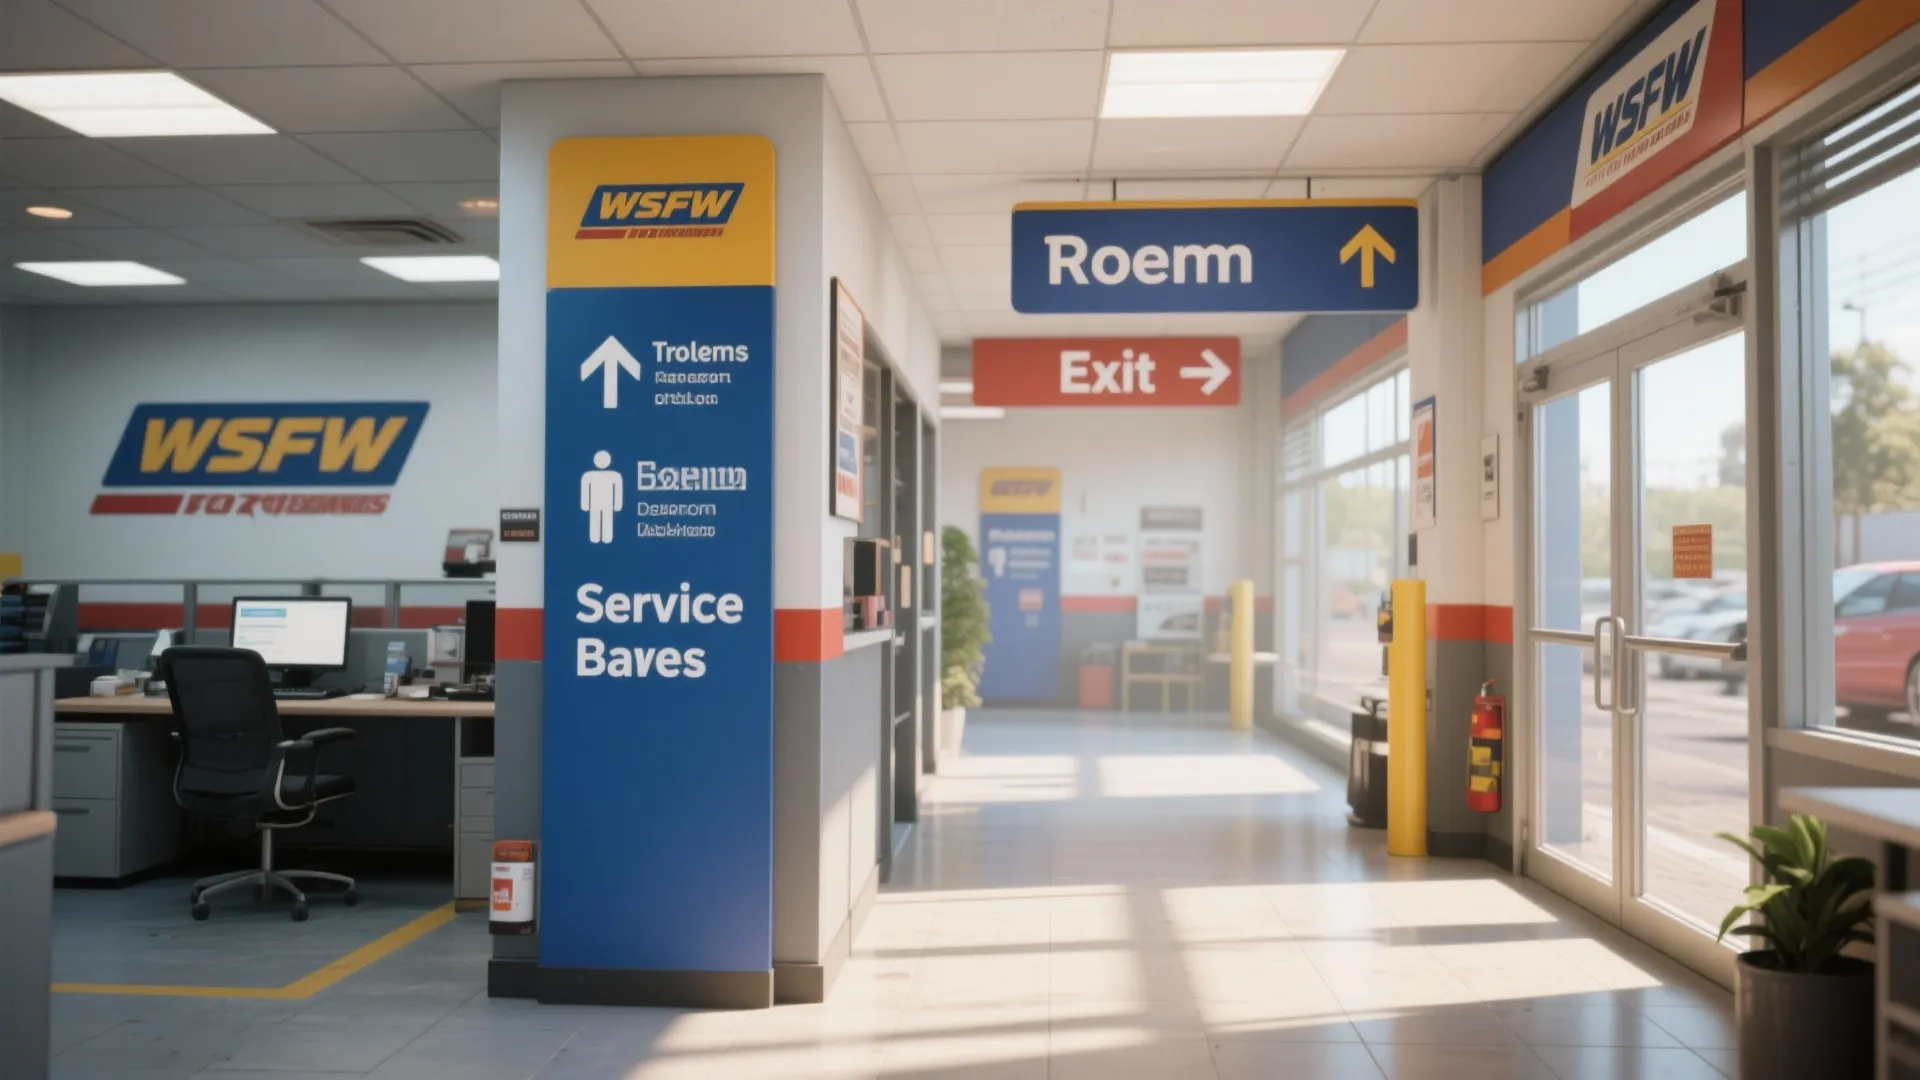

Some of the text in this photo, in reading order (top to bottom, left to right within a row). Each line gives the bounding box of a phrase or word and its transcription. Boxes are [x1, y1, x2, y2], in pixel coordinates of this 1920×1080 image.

[1591, 26, 1707, 165] WSFW
[599, 189, 734, 220] WSFW
[652, 340, 749, 363] Trolems
[1060, 348, 1156, 394] Exit
[139, 416, 408, 474] WSFW
[576, 581, 744, 624] Service
[576, 637, 707, 678] Baves
